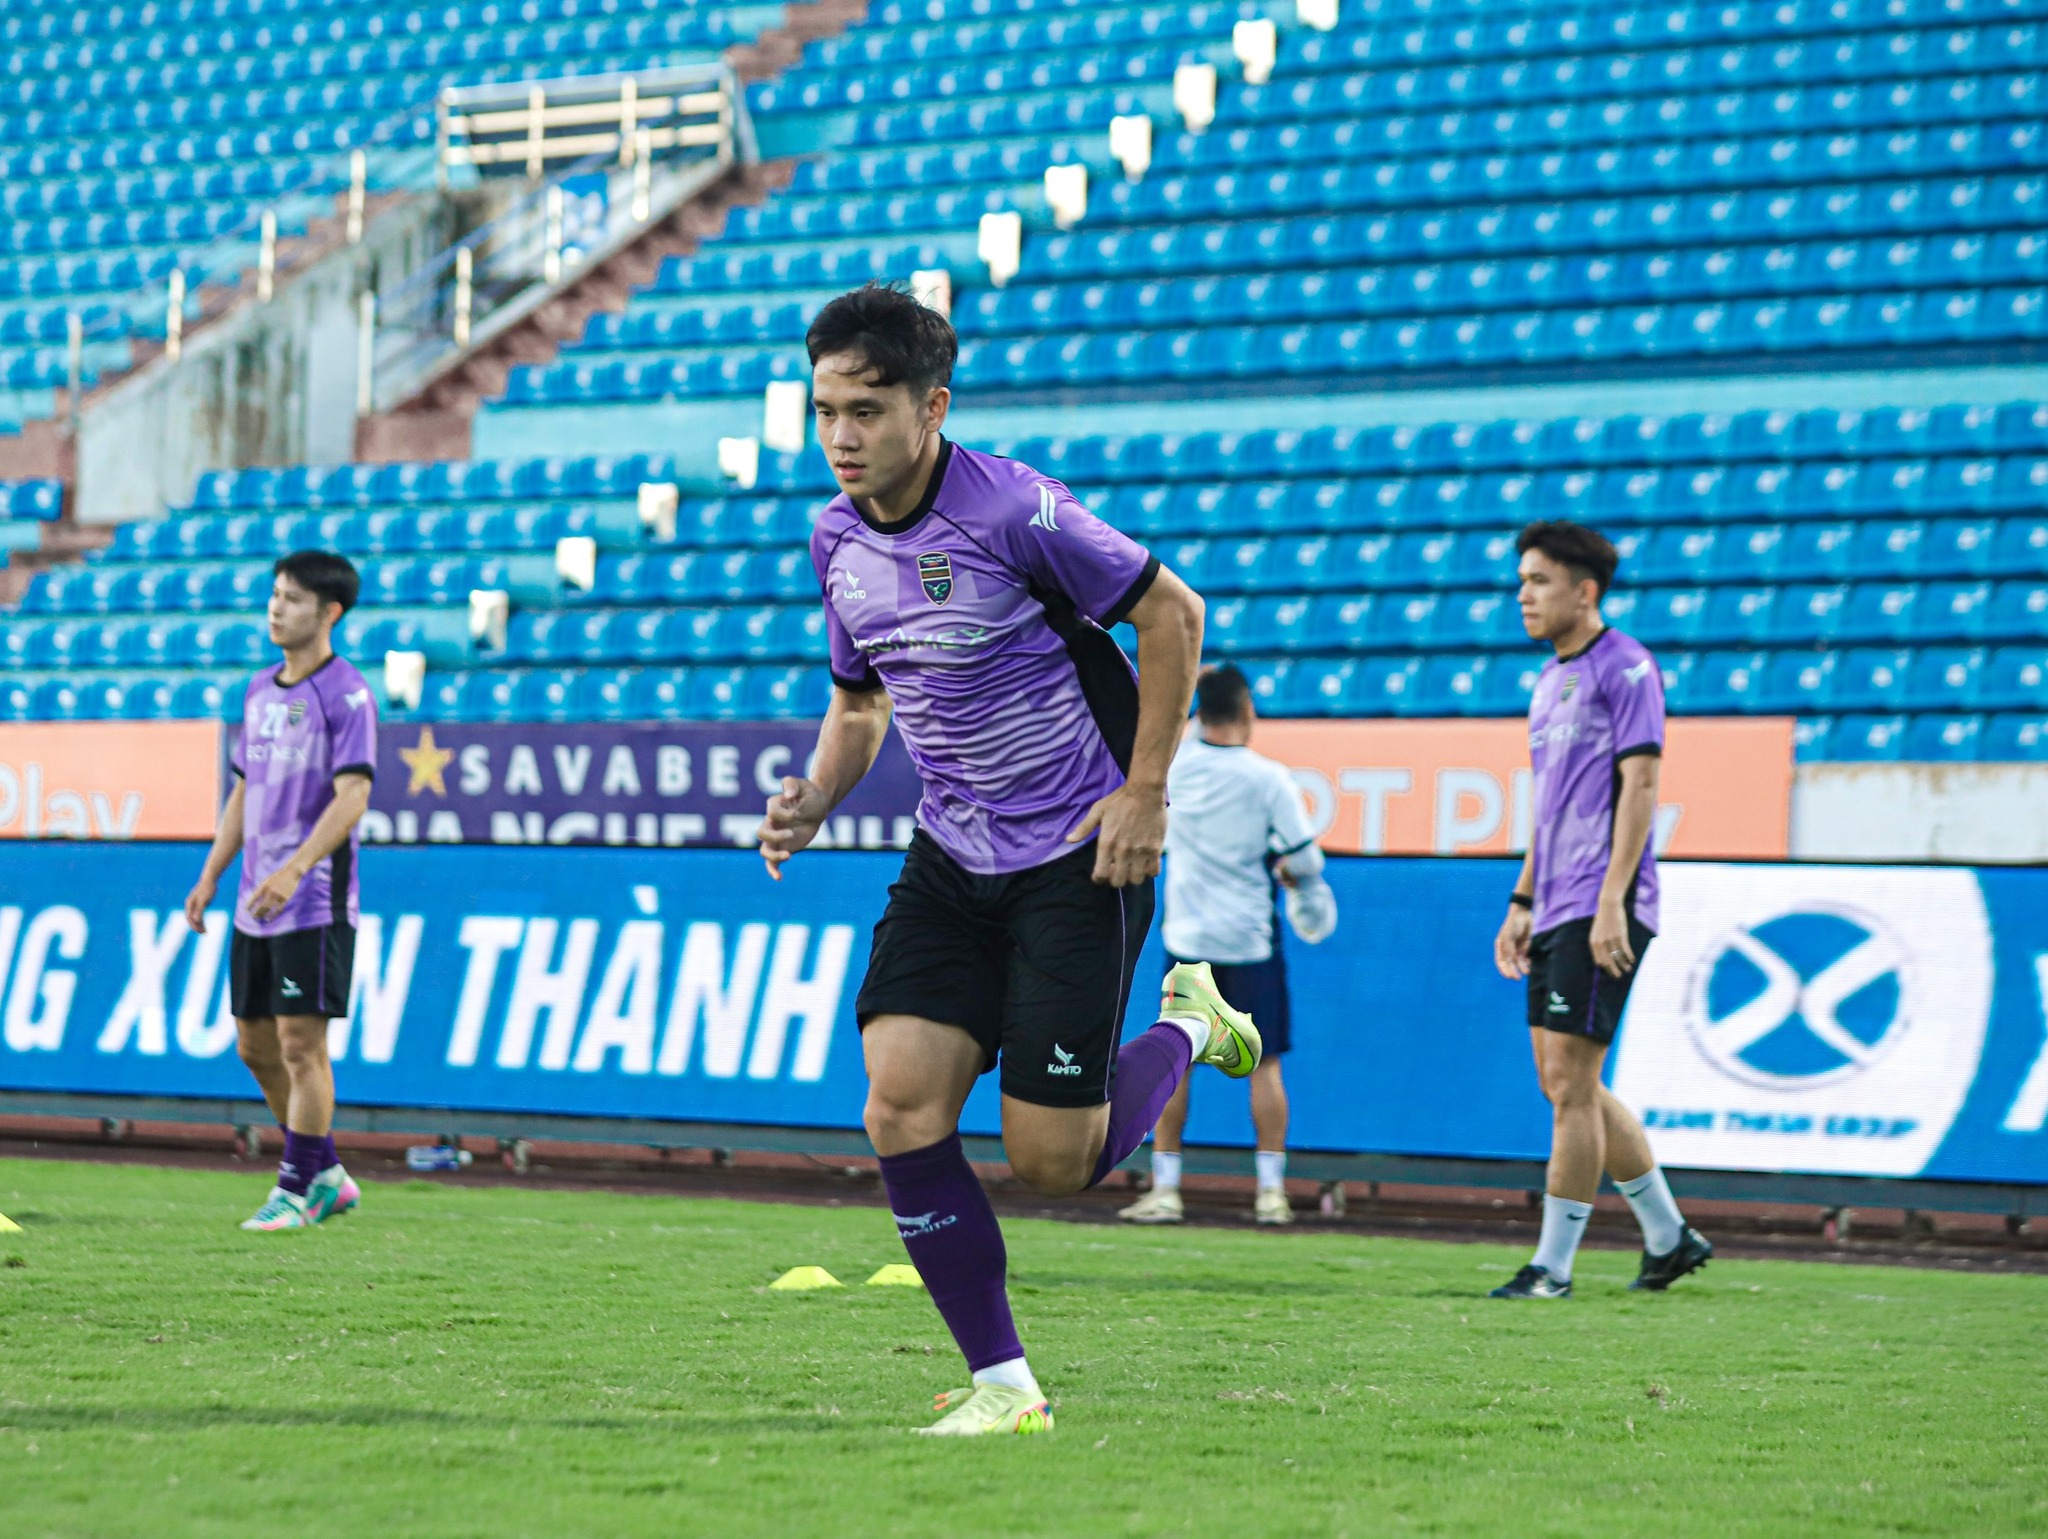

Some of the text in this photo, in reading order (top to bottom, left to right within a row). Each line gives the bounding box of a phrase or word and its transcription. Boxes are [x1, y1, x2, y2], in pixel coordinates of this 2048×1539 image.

[459, 744, 812, 797] SAVABEC
[446, 885, 855, 1082] THÀNH
[1047, 1063, 1082, 1075] KAMITO
